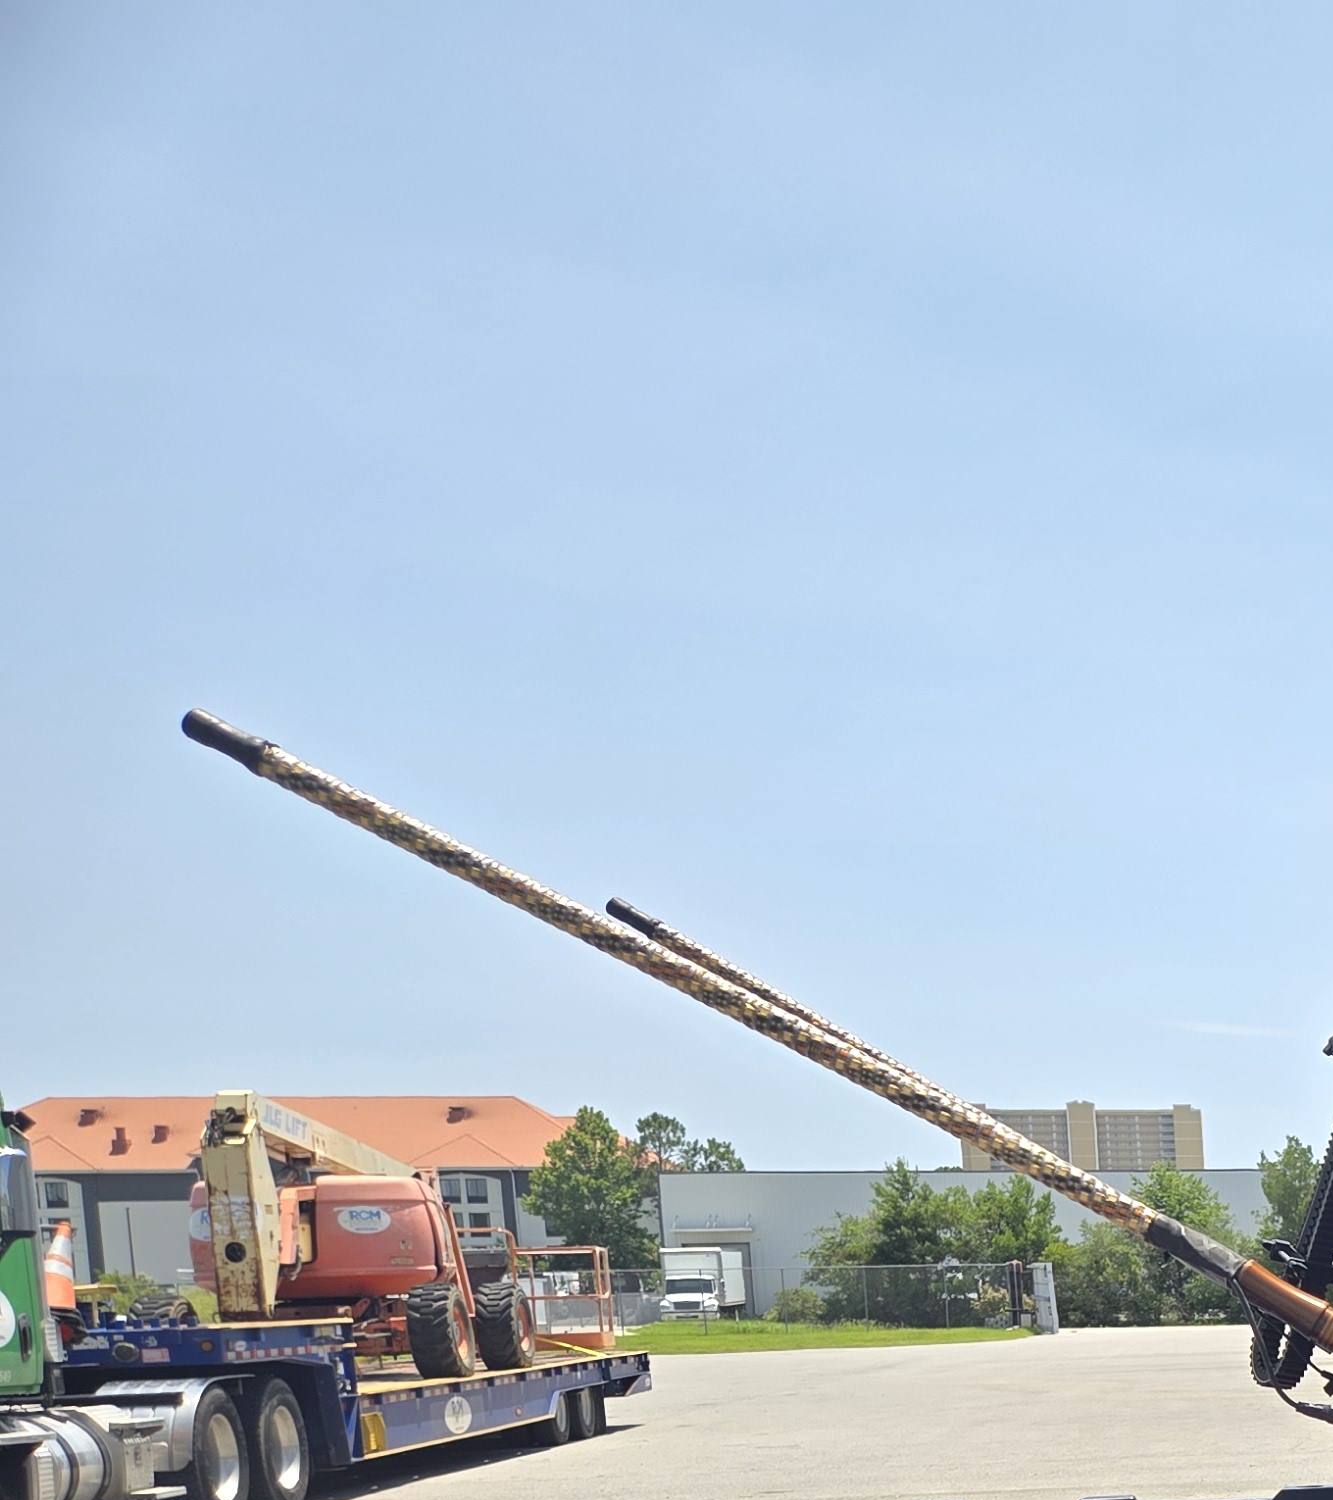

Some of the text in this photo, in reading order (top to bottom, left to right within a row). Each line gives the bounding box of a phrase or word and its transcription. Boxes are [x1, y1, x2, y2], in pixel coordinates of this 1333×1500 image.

[262, 1103, 309, 1141] JLG LIFT
[348, 1209, 382, 1221] RCM
